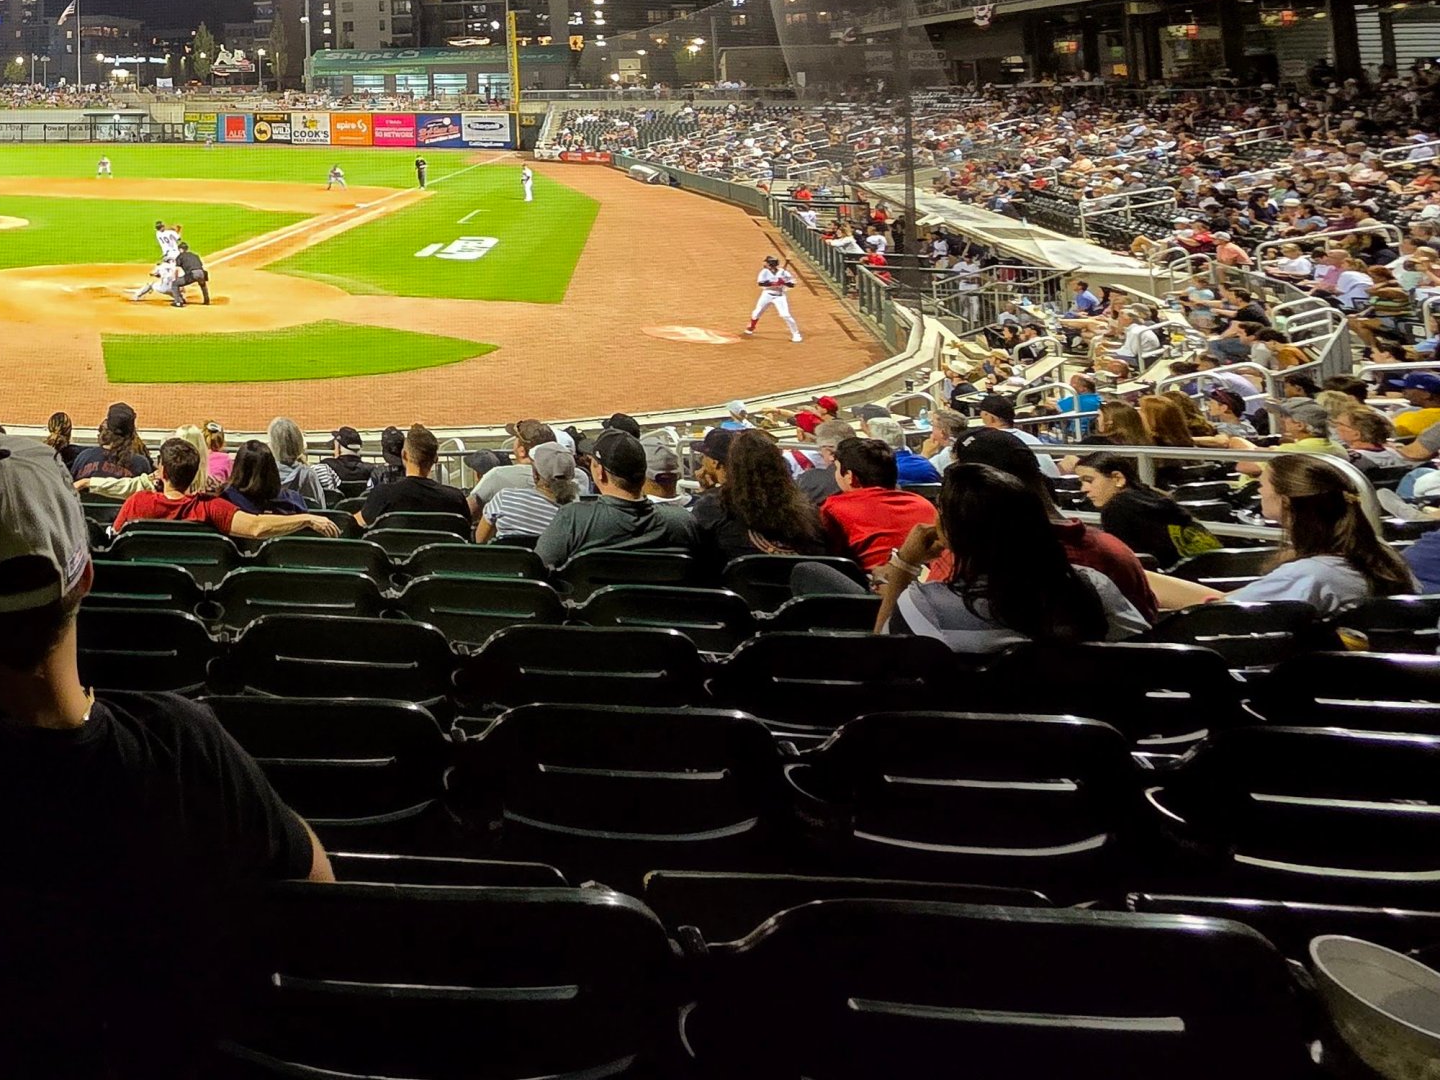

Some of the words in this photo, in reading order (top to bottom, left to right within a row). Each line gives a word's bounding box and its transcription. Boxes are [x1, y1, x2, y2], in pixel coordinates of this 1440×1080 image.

[324, 51, 395, 61] Shipt
[336, 122, 357, 131] spire
[293, 130, 329, 138] COOK'S
